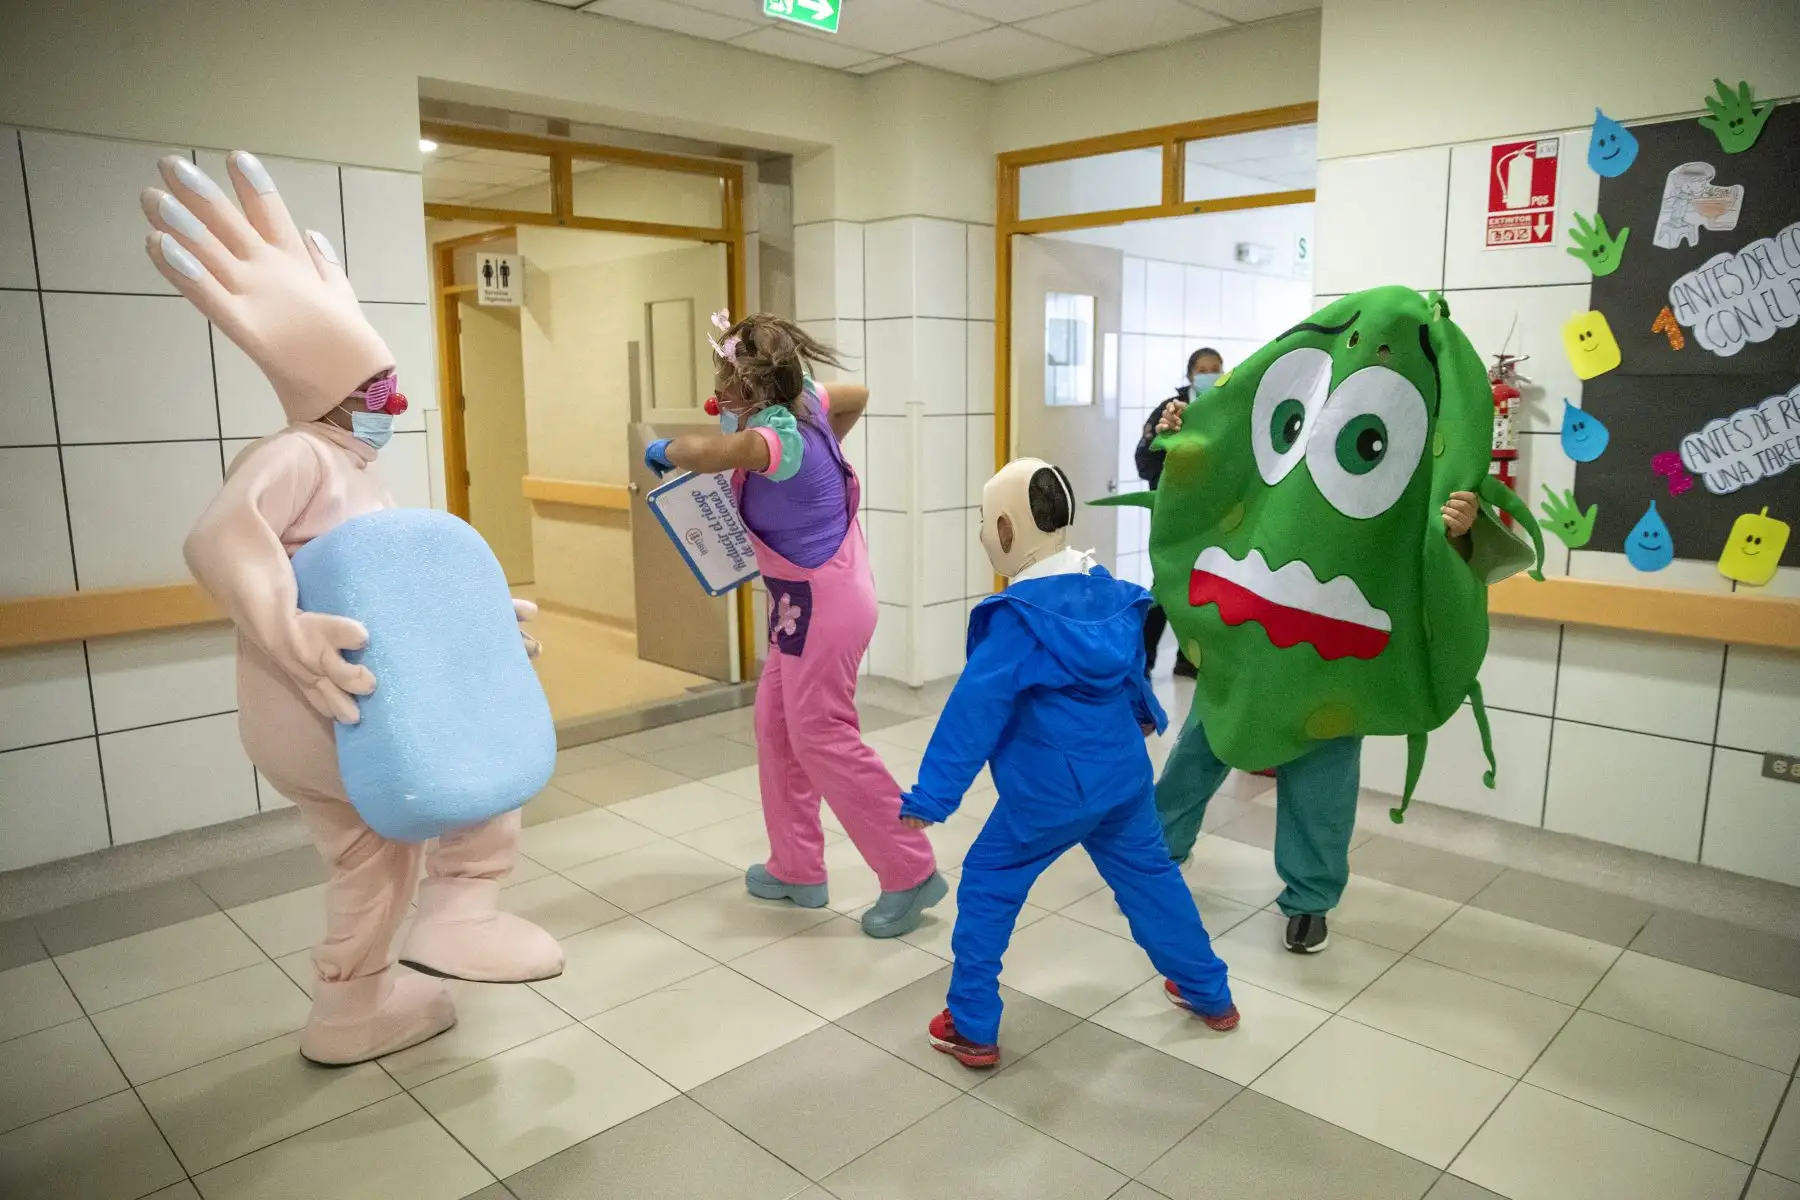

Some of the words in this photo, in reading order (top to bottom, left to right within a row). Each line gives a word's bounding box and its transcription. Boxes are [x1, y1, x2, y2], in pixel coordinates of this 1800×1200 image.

[1488, 216, 1532, 226] EXTINTOR
[1673, 259, 1744, 320] ANTES
[1741, 244, 1787, 290] DEL
[1705, 299, 1763, 349] CON
[1760, 288, 1794, 323] EL
[1684, 419, 1753, 470] ANTES
[1750, 408, 1780, 441] DE
[1709, 460, 1754, 491] UNA
[691, 489, 715, 522] riesgo
[707, 490, 748, 545] infecciones
[708, 520, 723, 533] el
[716, 531, 747, 572] Reducir
[741, 544, 754, 557] de
